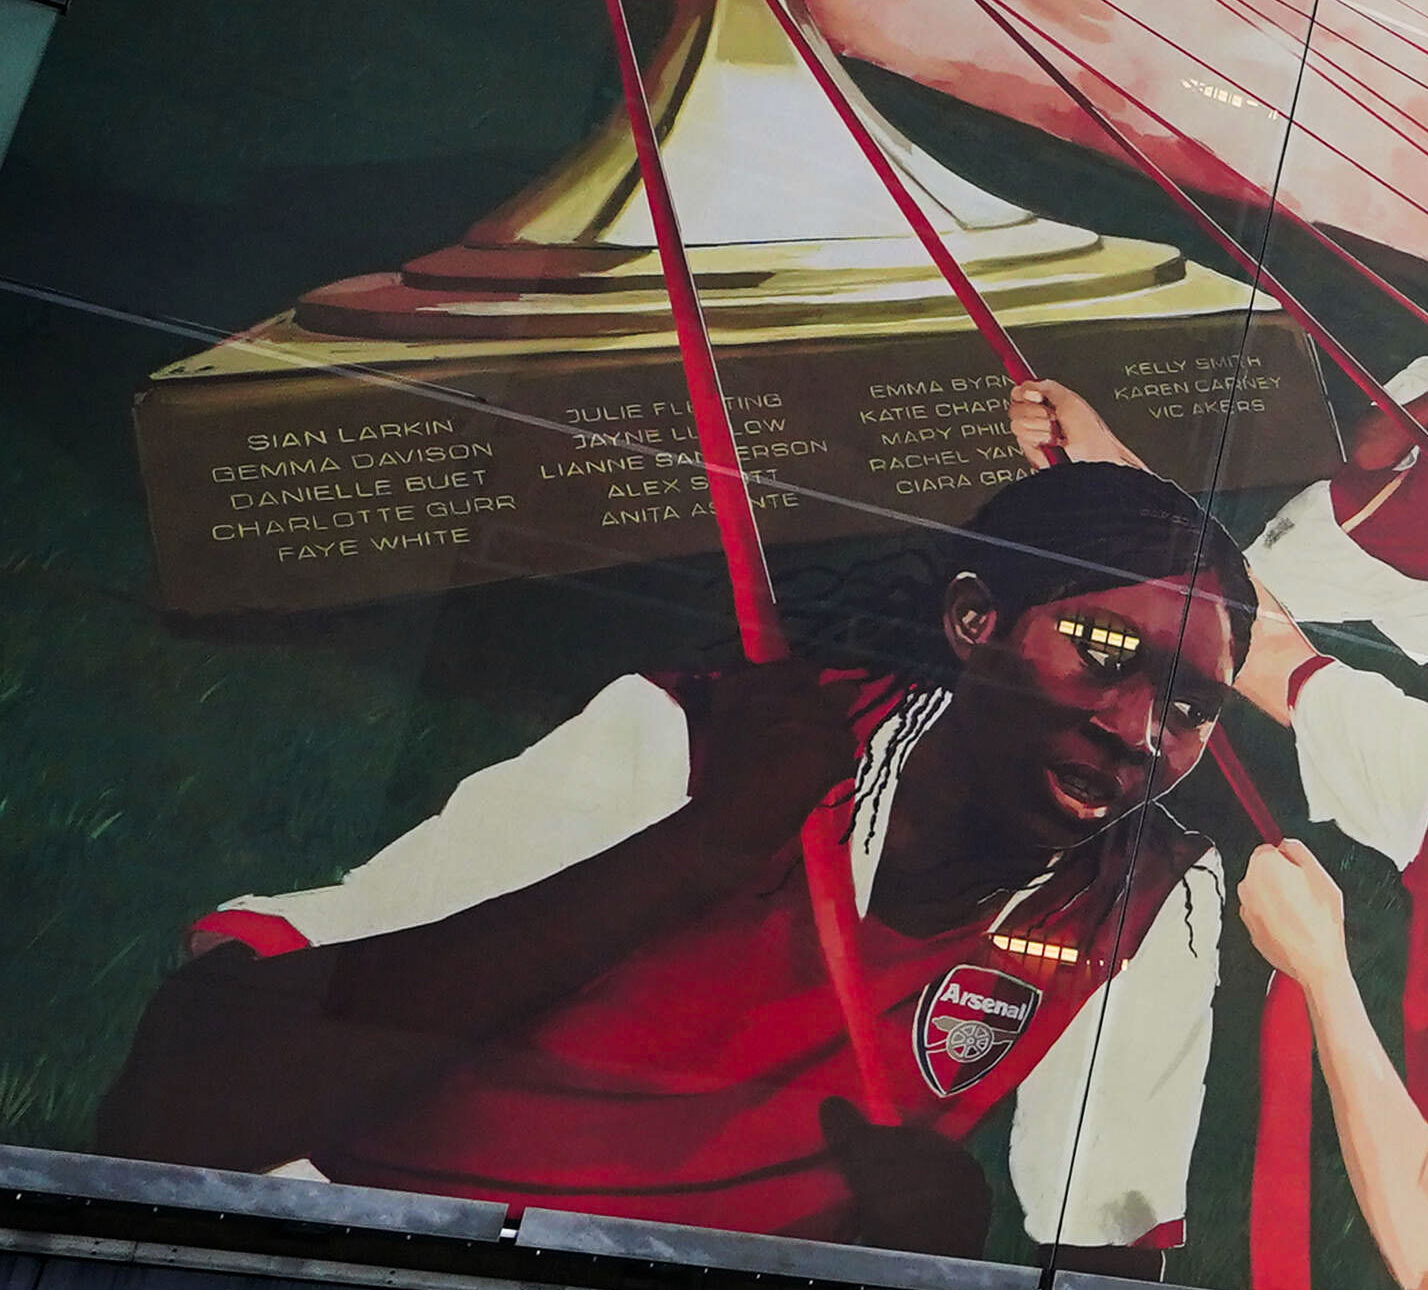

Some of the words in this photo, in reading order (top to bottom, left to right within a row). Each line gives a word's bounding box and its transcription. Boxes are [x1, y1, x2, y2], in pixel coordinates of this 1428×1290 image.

[1125, 360, 1187, 377] KELLY
[1195, 354, 1262, 370] SMITH
[870, 380, 944, 400] EMMA
[1114, 381, 1190, 400] KAREN
[1194, 376, 1281, 393] CARNEY
[566, 403, 644, 424] JULIE
[860, 405, 930, 424] KATIE
[1149, 404, 1184, 419] VIC
[1192, 399, 1266, 415] AKERS
[248, 430, 327, 451] SIAN
[338, 419, 455, 444] LARKIN
[572, 429, 663, 450] JAYNE
[211, 456, 341, 484] GEMMA
[350, 442, 494, 470] DAVISON
[540, 454, 645, 479] LIANNE
[868, 450, 970, 473] RACHEL
[230, 478, 393, 511] DANIELLE
[405, 469, 487, 494] BUET
[607, 478, 681, 499] ALEX
[896, 474, 972, 495] CIARA
[211, 505, 416, 542] CHARLOTTE
[426, 494, 518, 518] GURR
[601, 505, 681, 527] ANITA
[278, 539, 360, 563] FAYE
[369, 527, 472, 552] WHITE
[939, 981, 1027, 1022] Arsenal
